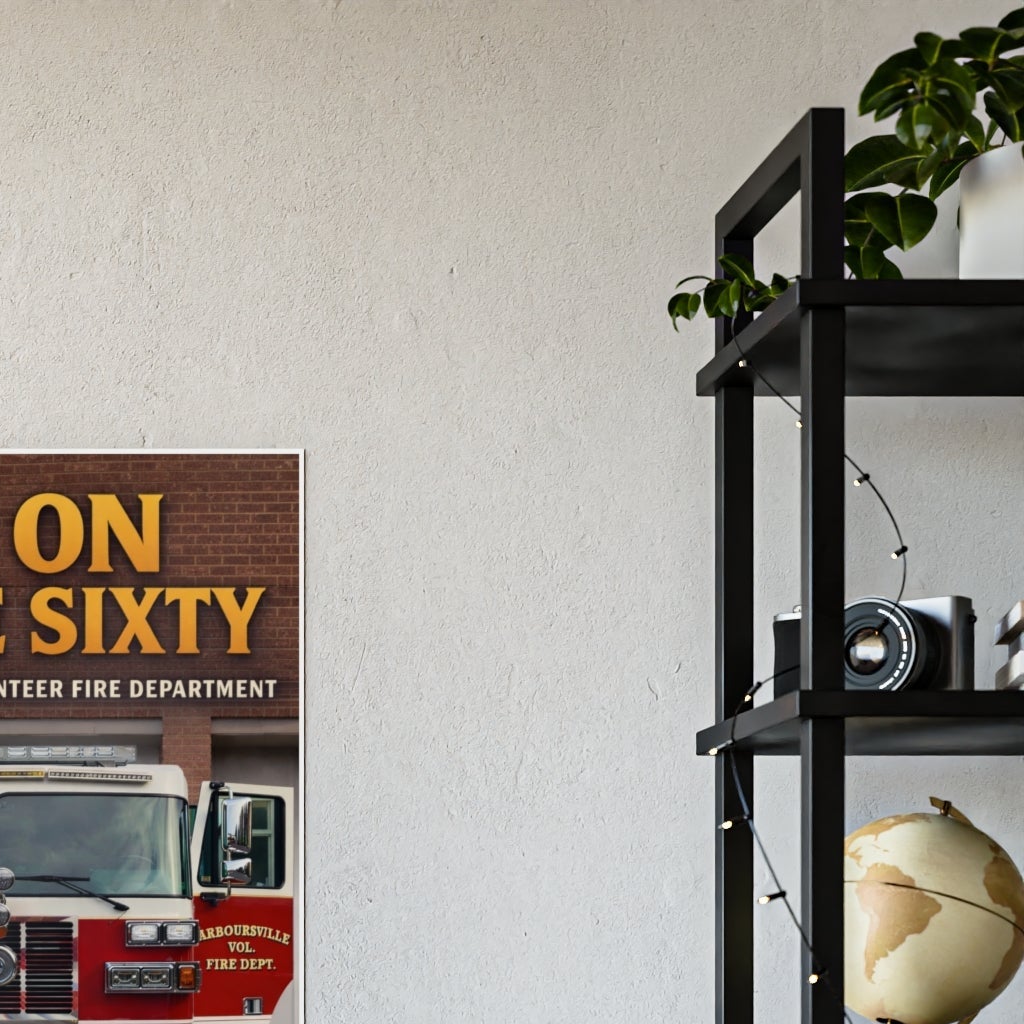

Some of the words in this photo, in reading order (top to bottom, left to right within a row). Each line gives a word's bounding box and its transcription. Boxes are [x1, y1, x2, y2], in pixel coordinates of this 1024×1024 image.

[13, 493, 163, 573] ON
[30, 586, 266, 655] SIXTY
[72, 679, 121, 698] FIRE
[129, 679, 277, 698] DEPARTMENT
[227, 942, 256, 953] VOL.
[206, 959, 237, 970] FIRE
[240, 959, 277, 970] DEPT.
